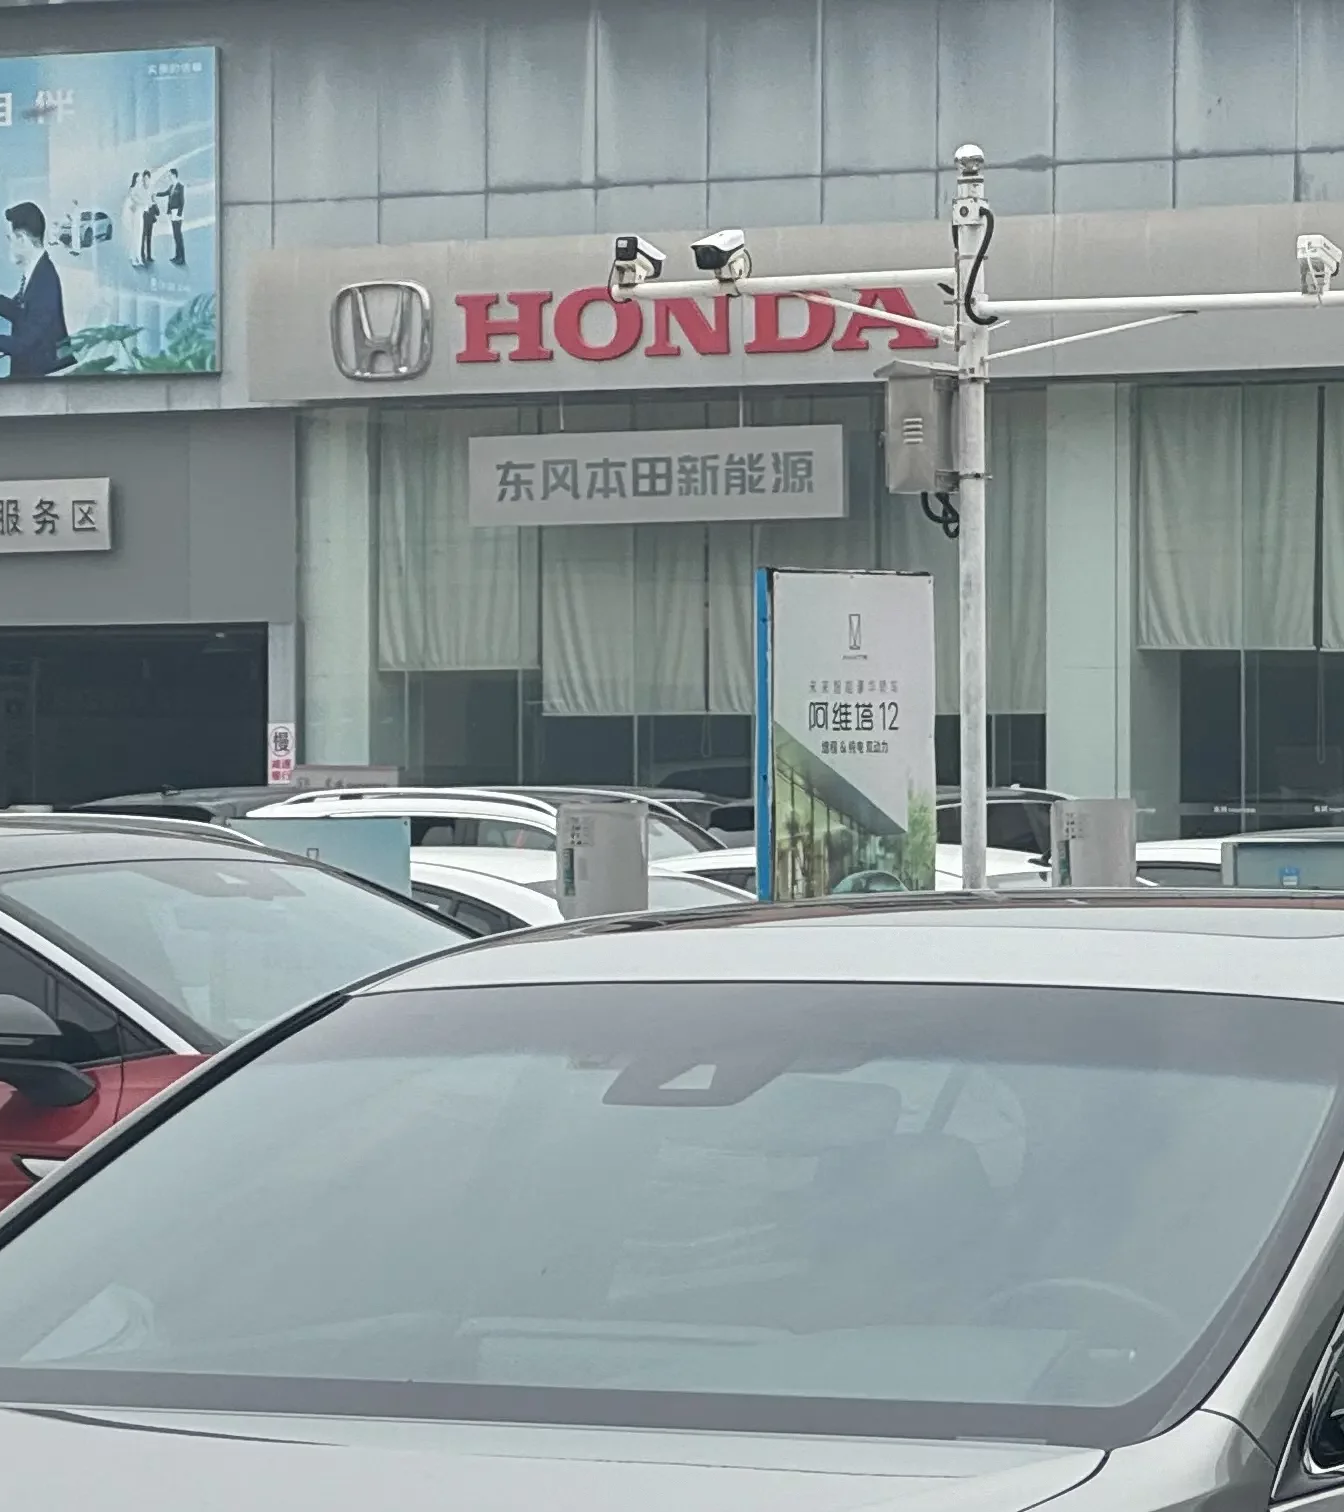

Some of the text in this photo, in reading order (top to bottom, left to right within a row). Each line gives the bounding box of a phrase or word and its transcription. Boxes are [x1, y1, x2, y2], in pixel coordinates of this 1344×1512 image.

[456, 286, 940, 364] HONDA
[496, 450, 815, 503] 东风本田新能源
[273, 731, 290, 752] 慢
